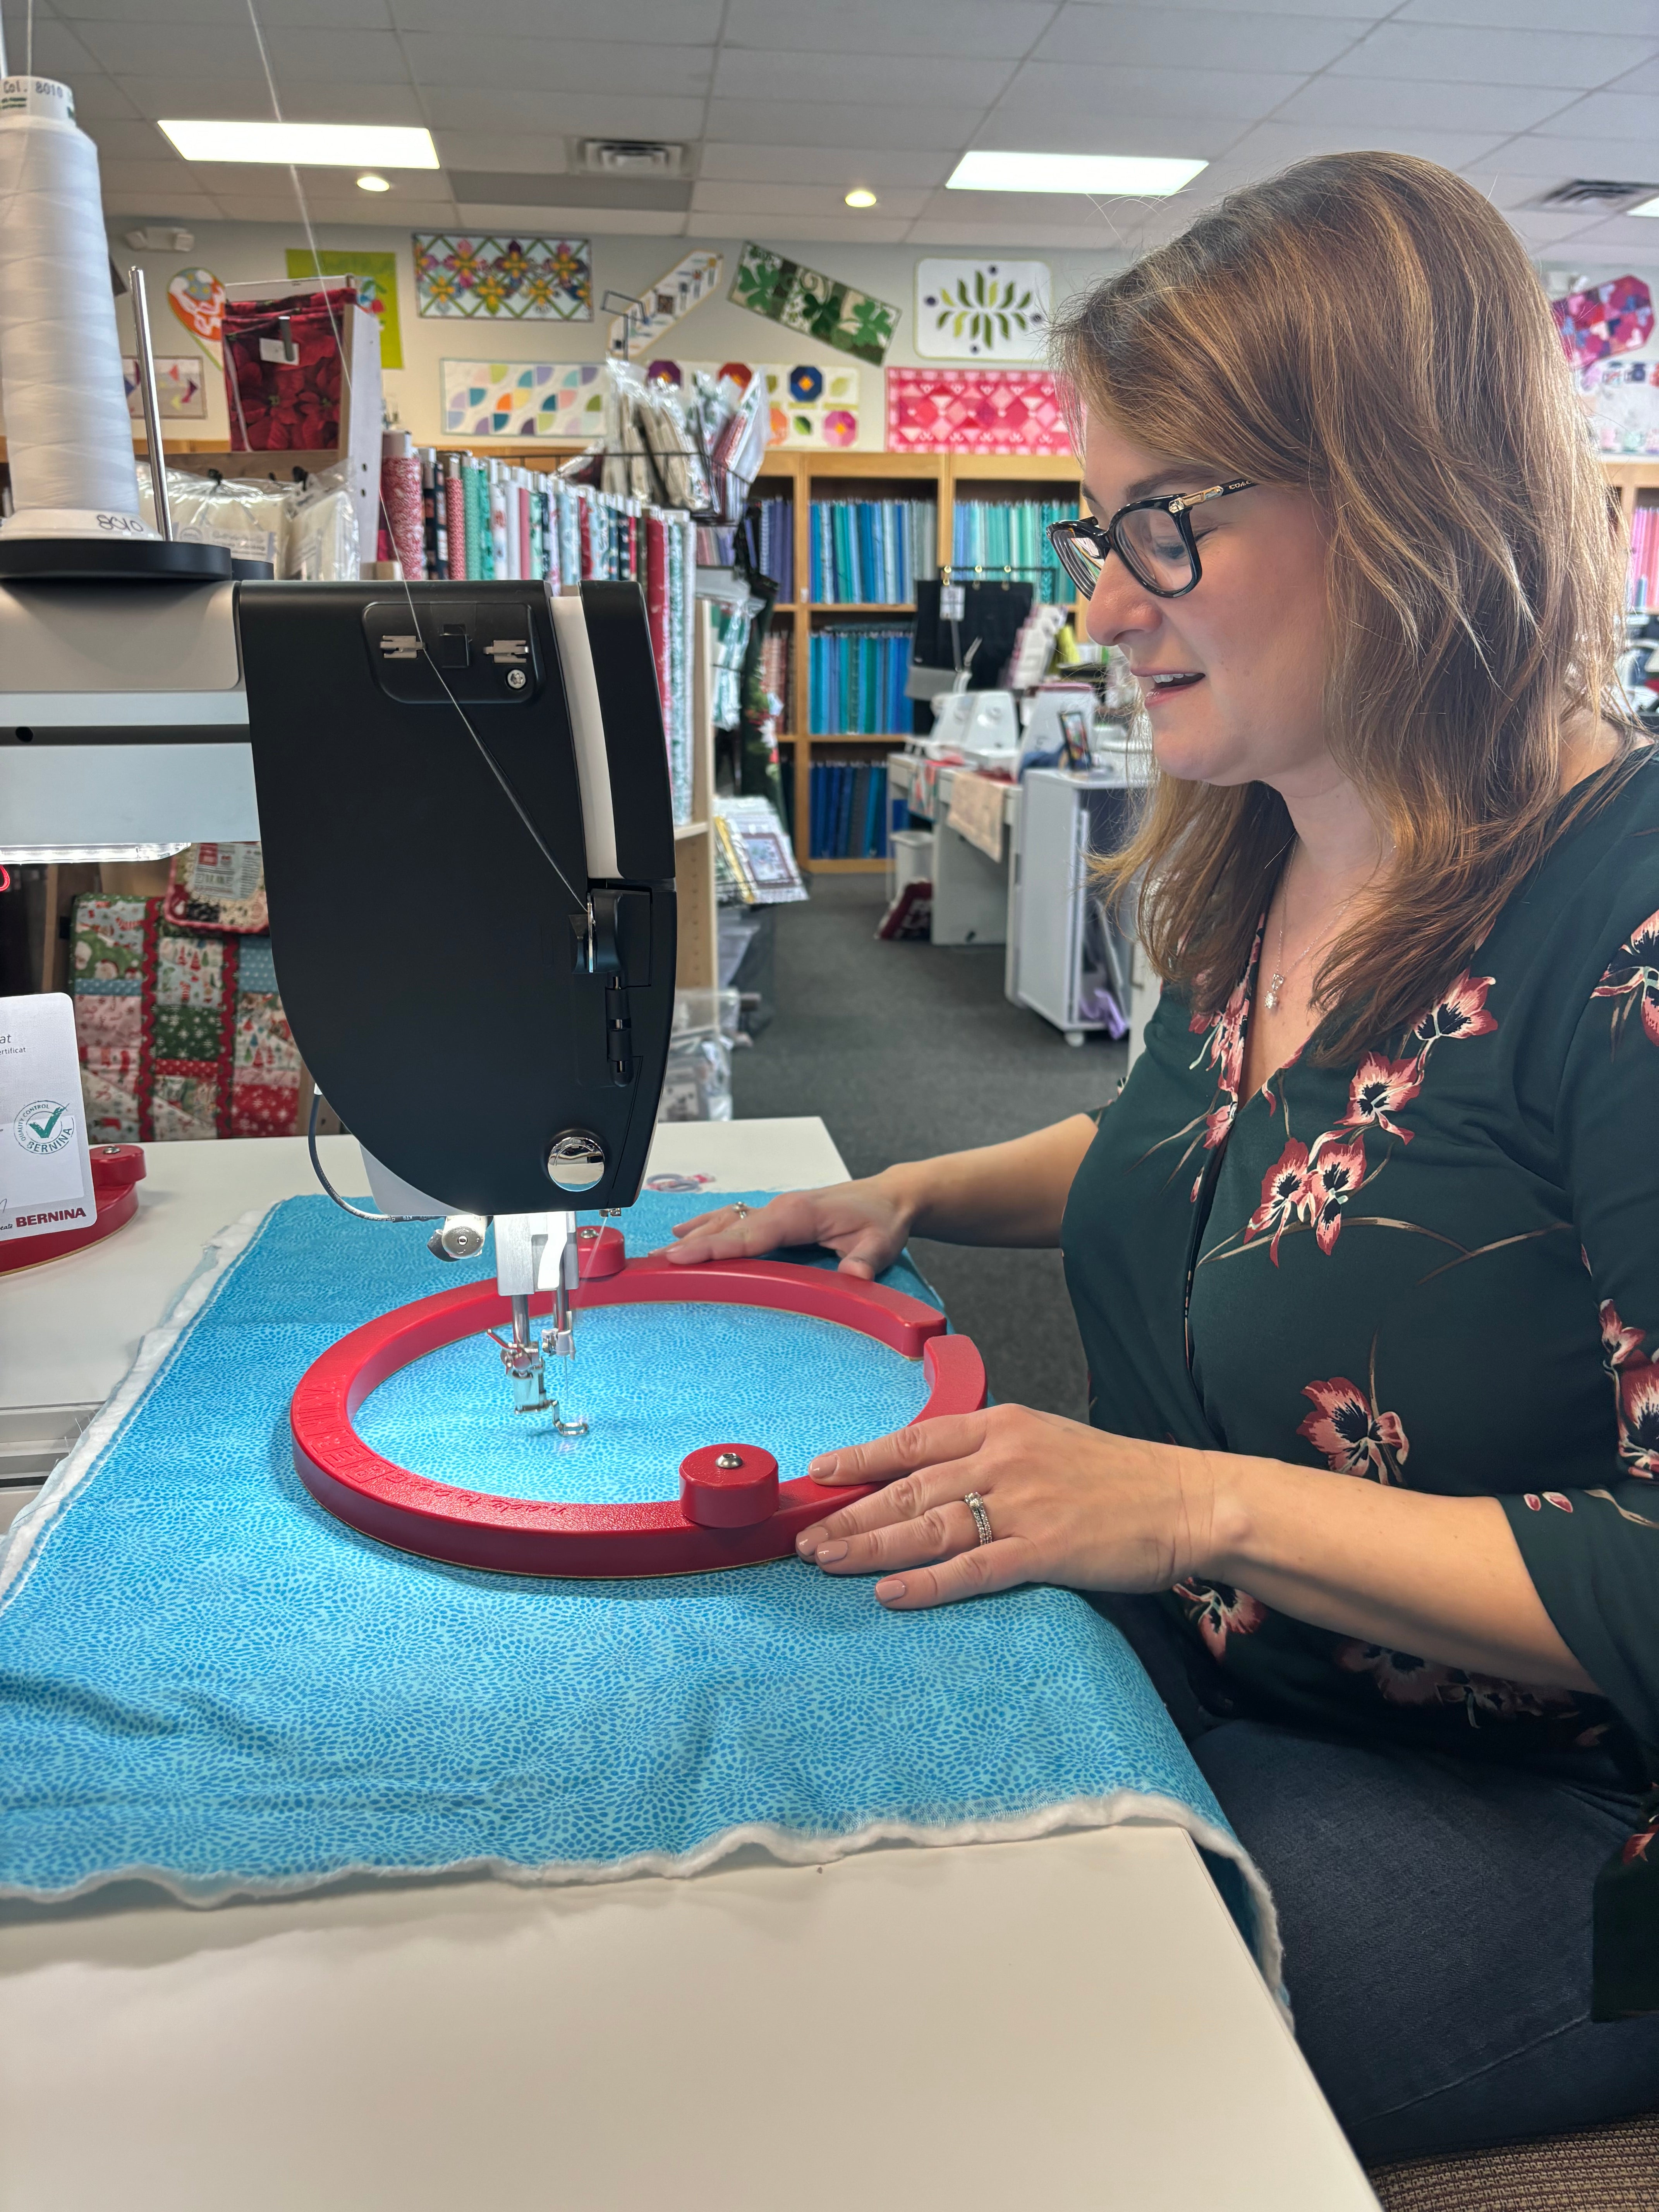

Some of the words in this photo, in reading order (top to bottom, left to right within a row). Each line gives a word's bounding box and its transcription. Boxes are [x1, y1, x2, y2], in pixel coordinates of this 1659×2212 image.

[35, 81, 63, 98] 8010
[96, 514, 143, 532] 8010
[17, 1118, 26, 1141] QUALITY
[23, 1104, 50, 1117] CONTROL
[27, 1128, 72, 1152] BERNINA
[15, 1207, 86, 1227] BERNINA
[297, 1375, 398, 1484] BERNINA
[457, 1494, 481, 1507] to
[491, 1499, 567, 1514] made
